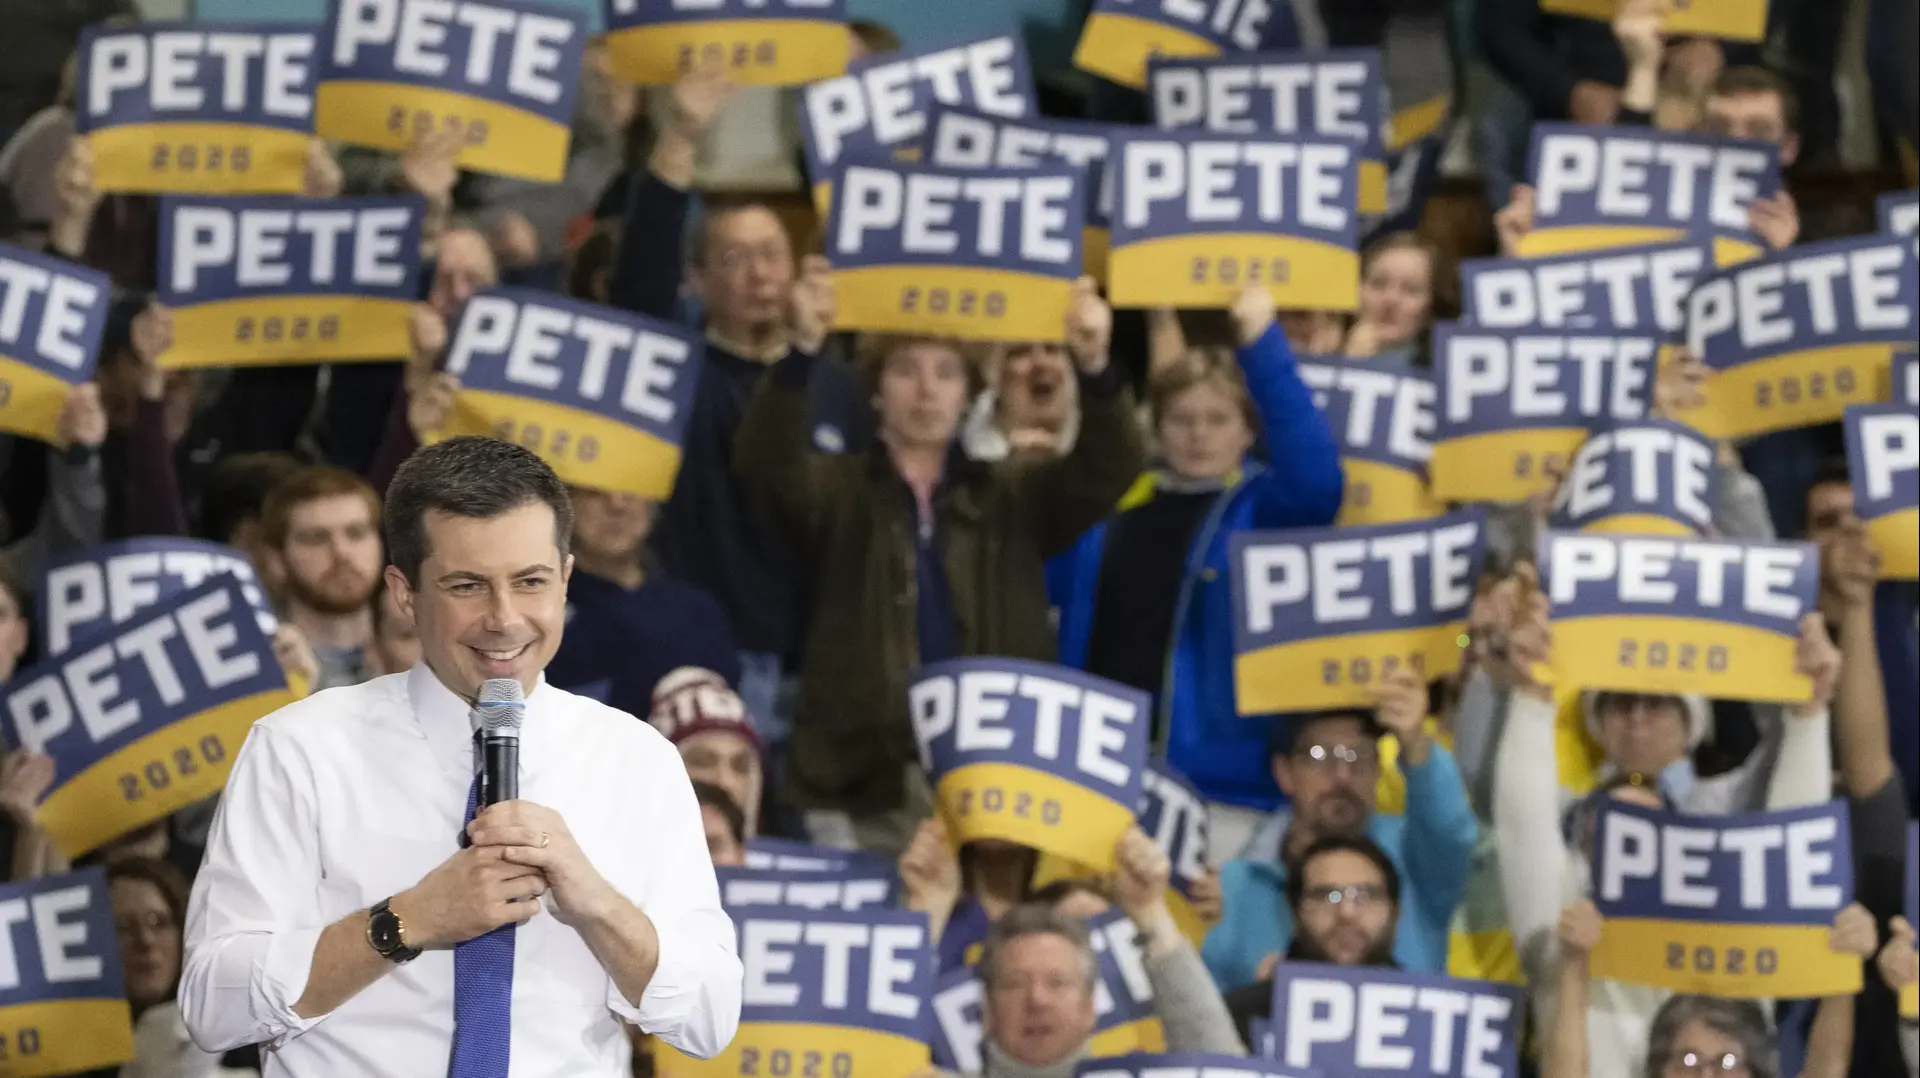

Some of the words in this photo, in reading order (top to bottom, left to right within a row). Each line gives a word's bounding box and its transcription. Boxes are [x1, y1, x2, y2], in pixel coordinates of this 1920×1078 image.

[88, 32, 314, 117] PETE
[333, 0, 574, 103] PETE
[806, 36, 1026, 165] PETE
[1152, 61, 1369, 141] PETE
[152, 144, 250, 170] 2020
[1123, 140, 1350, 230] PETE
[1535, 134, 1769, 231] PETE
[171, 206, 411, 293] PETE
[838, 166, 1074, 263] PETE
[902, 289, 1006, 317] 2020
[1191, 256, 1290, 284] 2020
[1683, 245, 1912, 360] PETE
[236, 316, 340, 342] 2020
[445, 295, 692, 424] PETE
[1446, 335, 1655, 424] PETE
[1755, 365, 1857, 409] 2020
[1556, 427, 1714, 526] ETE
[1244, 521, 1479, 634] PETE
[1549, 536, 1806, 620] PETE
[7, 588, 260, 757] PETE
[1616, 638, 1729, 674] 2020
[118, 733, 226, 802] 2020
[908, 670, 1136, 788] PETE
[957, 787, 1063, 827] 2020
[1602, 811, 1843, 910] PETE
[741, 918, 924, 1019] ETE
[1667, 943, 1779, 976] 2020
[739, 1047, 853, 1078] 2020
[1285, 977, 1512, 1078] PETE
